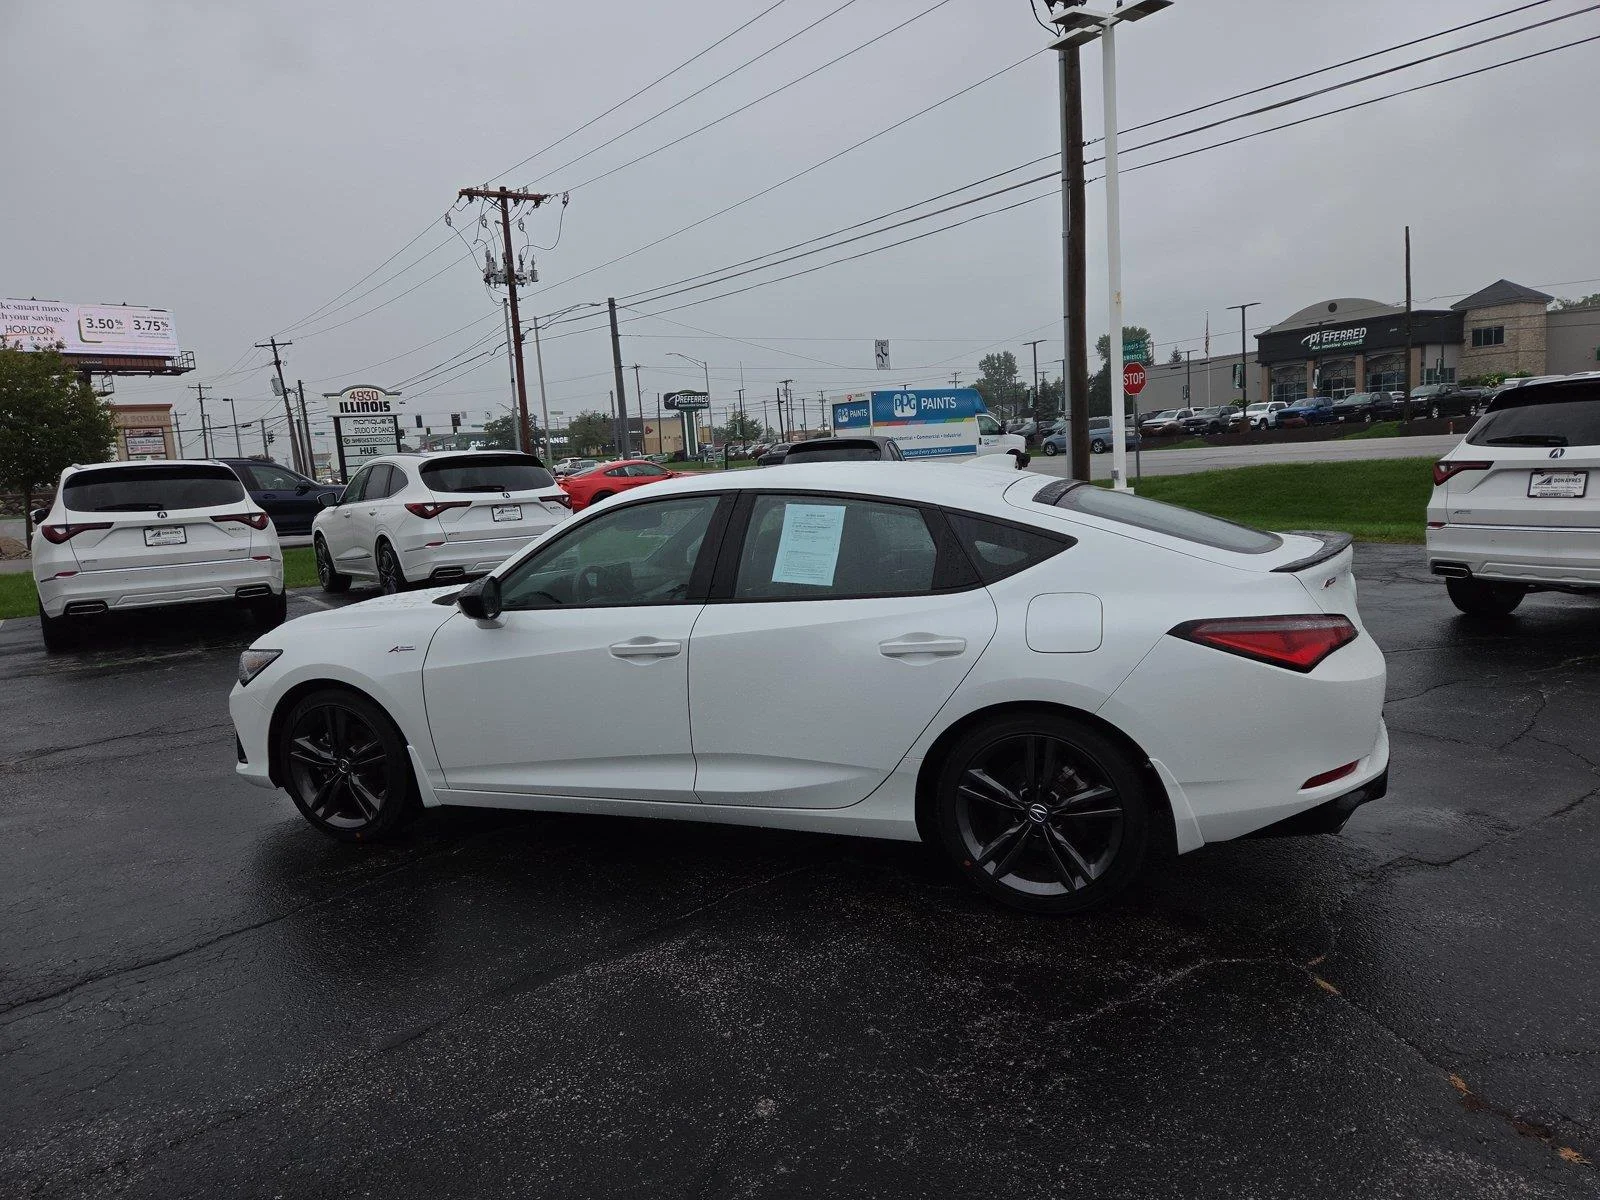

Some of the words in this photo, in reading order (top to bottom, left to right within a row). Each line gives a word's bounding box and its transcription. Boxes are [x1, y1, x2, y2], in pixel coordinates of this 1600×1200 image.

[13, 304, 40, 312] smart
[5, 325, 55, 335] HORIZON
[86, 318, 123, 330] 3.50%
[133, 320, 169, 332] 3.75%
[1123, 372, 1145, 386] STOP
[349, 391, 379, 402] 4930
[674, 394, 710, 406] PREFERRED
[339, 401, 391, 413] ILLINOIS
[921, 396, 957, 410] PAINTS
[849, 408, 868, 418] PAINTS
[359, 446, 378, 455] HUE
